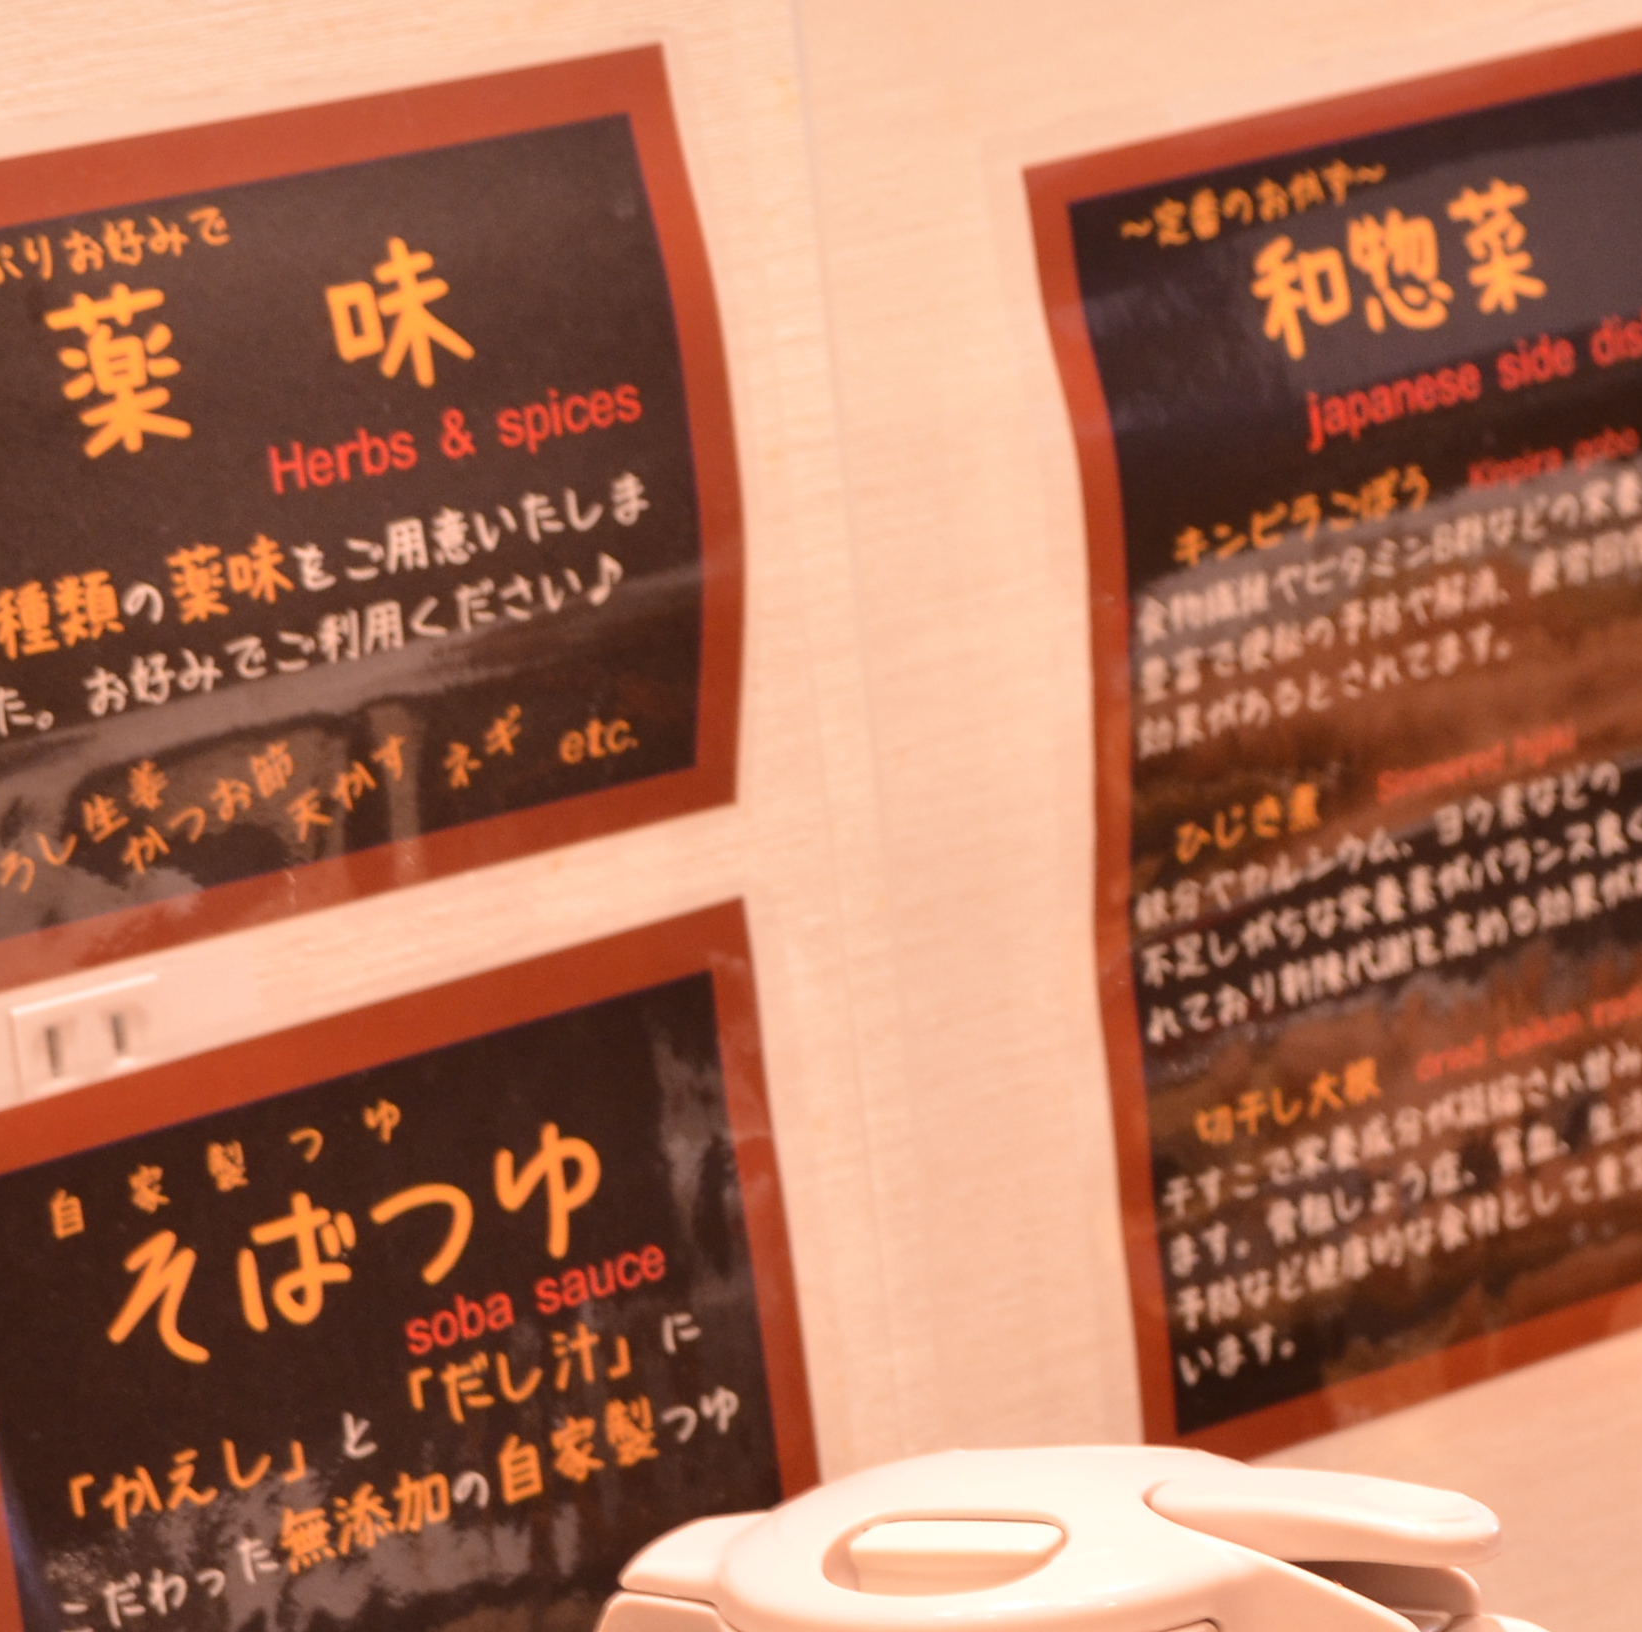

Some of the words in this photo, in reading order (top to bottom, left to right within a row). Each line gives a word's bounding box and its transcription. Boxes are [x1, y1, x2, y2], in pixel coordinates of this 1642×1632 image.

[1252, 180, 1546, 361] 和惣菜
[1497, 334, 1576, 391] side
[268, 430, 418, 495] Herbs
[438, 410, 476, 459] &
[497, 384, 643, 452] spices
[1172, 463, 1431, 566] キンピラごぼう
[122, 741, 297, 875] かつお節
[286, 735, 407, 841] 天かす
[444, 704, 522, 789] ネギ
[560, 713, 640, 766] etc.
[1174, 783, 1321, 864] ひじき煮
[1194, 1058, 1383, 1144] 切干し大根
[107, 1122, 601, 1363] そばつゆ
[405, 1290, 514, 1358] soba
[535, 1243, 667, 1315] sauce
[1179, 1325, 1296, 1387] います。
